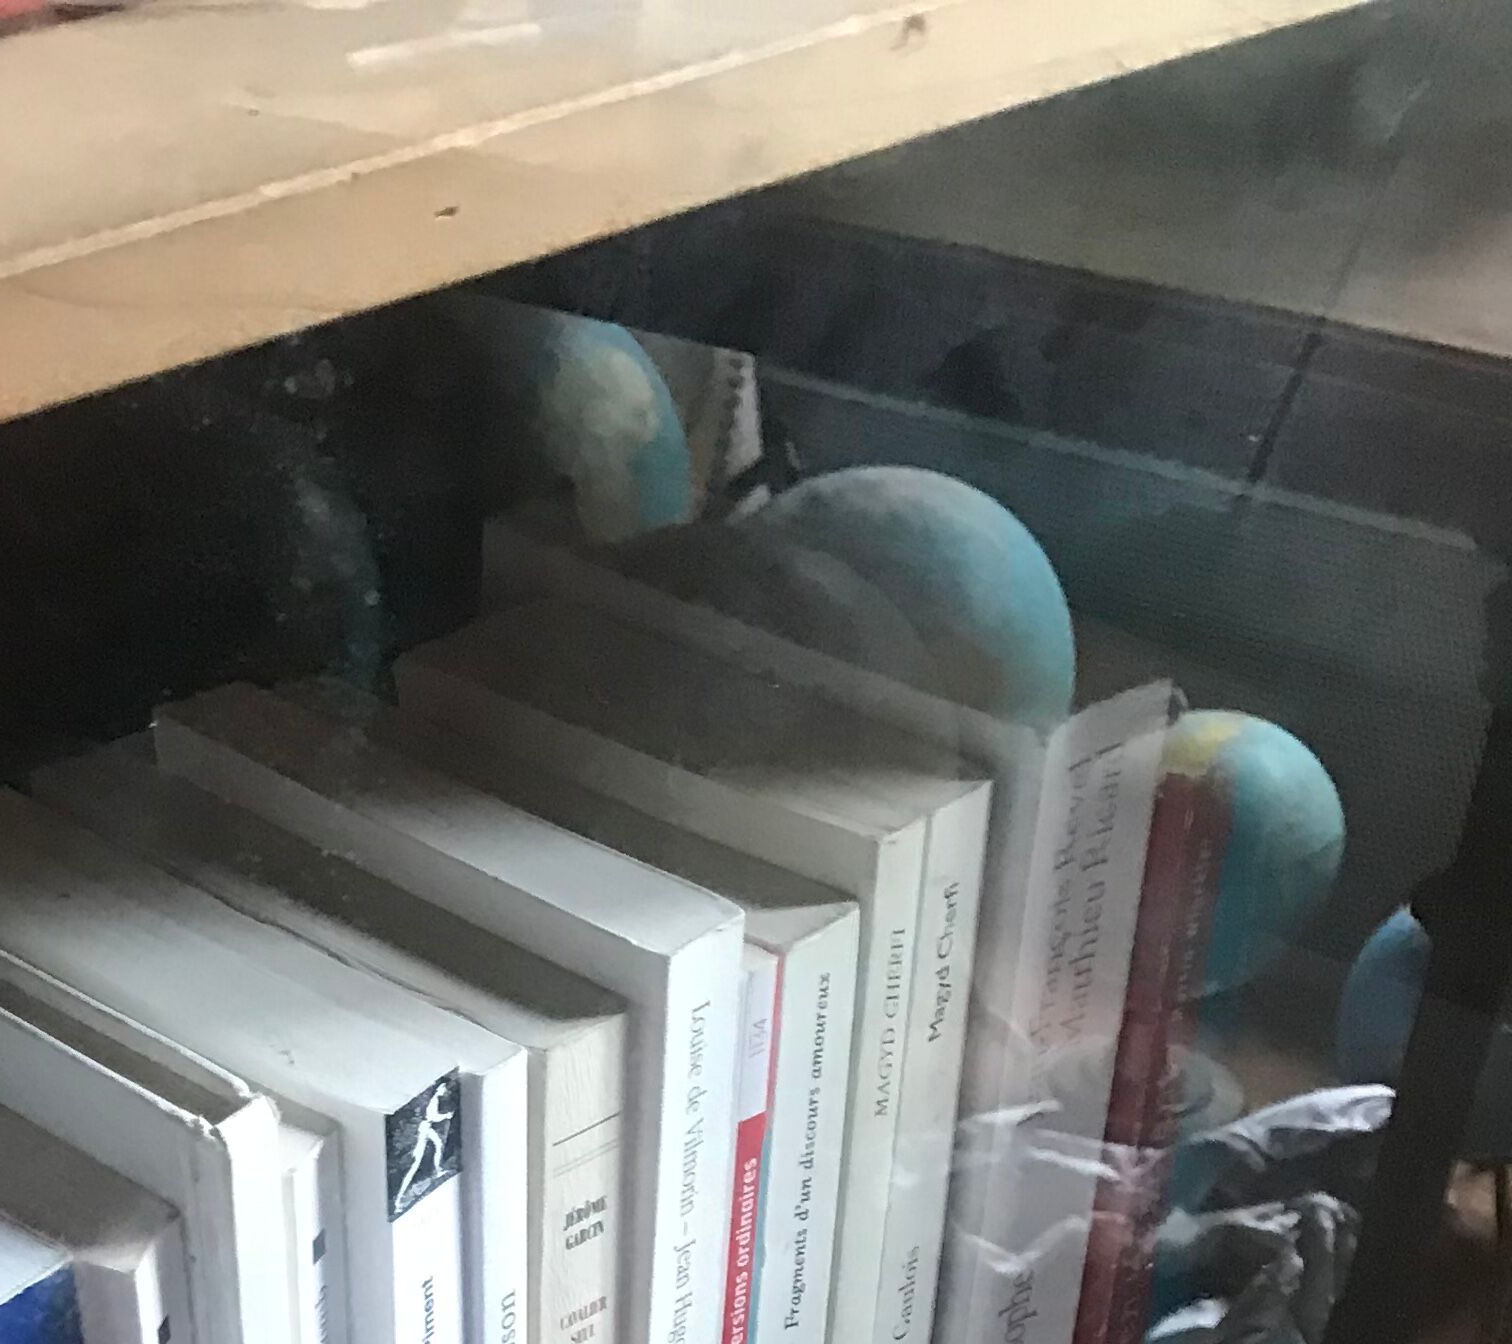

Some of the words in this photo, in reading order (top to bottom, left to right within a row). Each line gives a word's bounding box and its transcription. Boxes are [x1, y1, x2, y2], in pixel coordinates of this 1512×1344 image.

[937, 882, 959, 960] Cherfi
[688, 1000, 710, 1076] Louise
[811, 973, 830, 1079] amoureux
[874, 1028, 895, 1116] MAGYD
[886, 928, 905, 1018] CHERFI
[928, 965, 951, 1042] Magyd
[687, 1087, 708, 1112] de
[800, 1086, 820, 1170] discours
[680, 1118, 704, 1217] Vilmorin
[794, 1176, 812, 1221] d'un
[565, 1220, 604, 1250] GARCIN
[738, 1157, 758, 1268] ordinaires
[674, 1238, 695, 1290] Jean
[785, 1228, 808, 1330] Fragments
